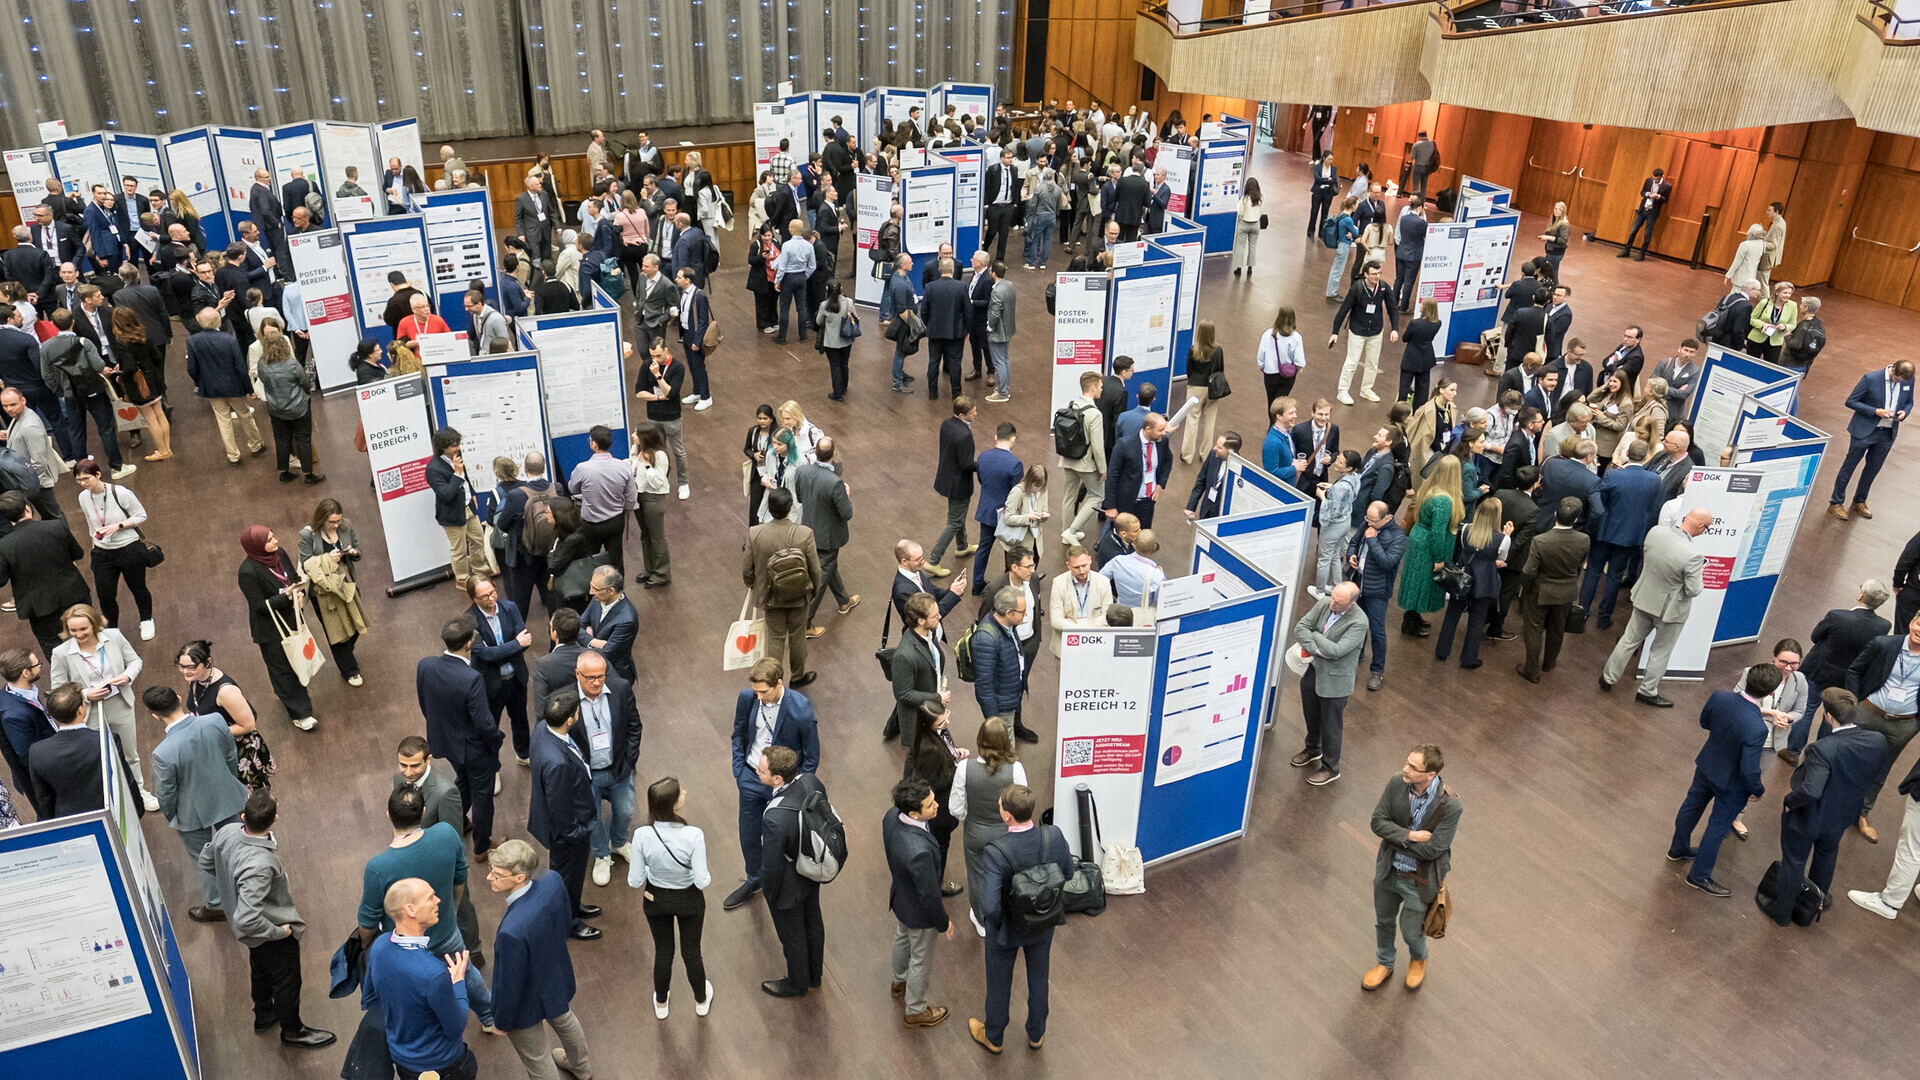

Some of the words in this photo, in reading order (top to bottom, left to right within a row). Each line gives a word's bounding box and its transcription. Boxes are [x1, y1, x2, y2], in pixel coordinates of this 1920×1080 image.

[299, 268, 330, 278] POSTER-
[300, 276, 332, 286] BEREICH
[370, 425, 408, 440] POSTER-
[372, 434, 410, 450] BEREICH
[1065, 688, 1120, 699] POSTER-
[1064, 701, 1118, 712] BEREICH
[1122, 701, 1136, 710] 12
